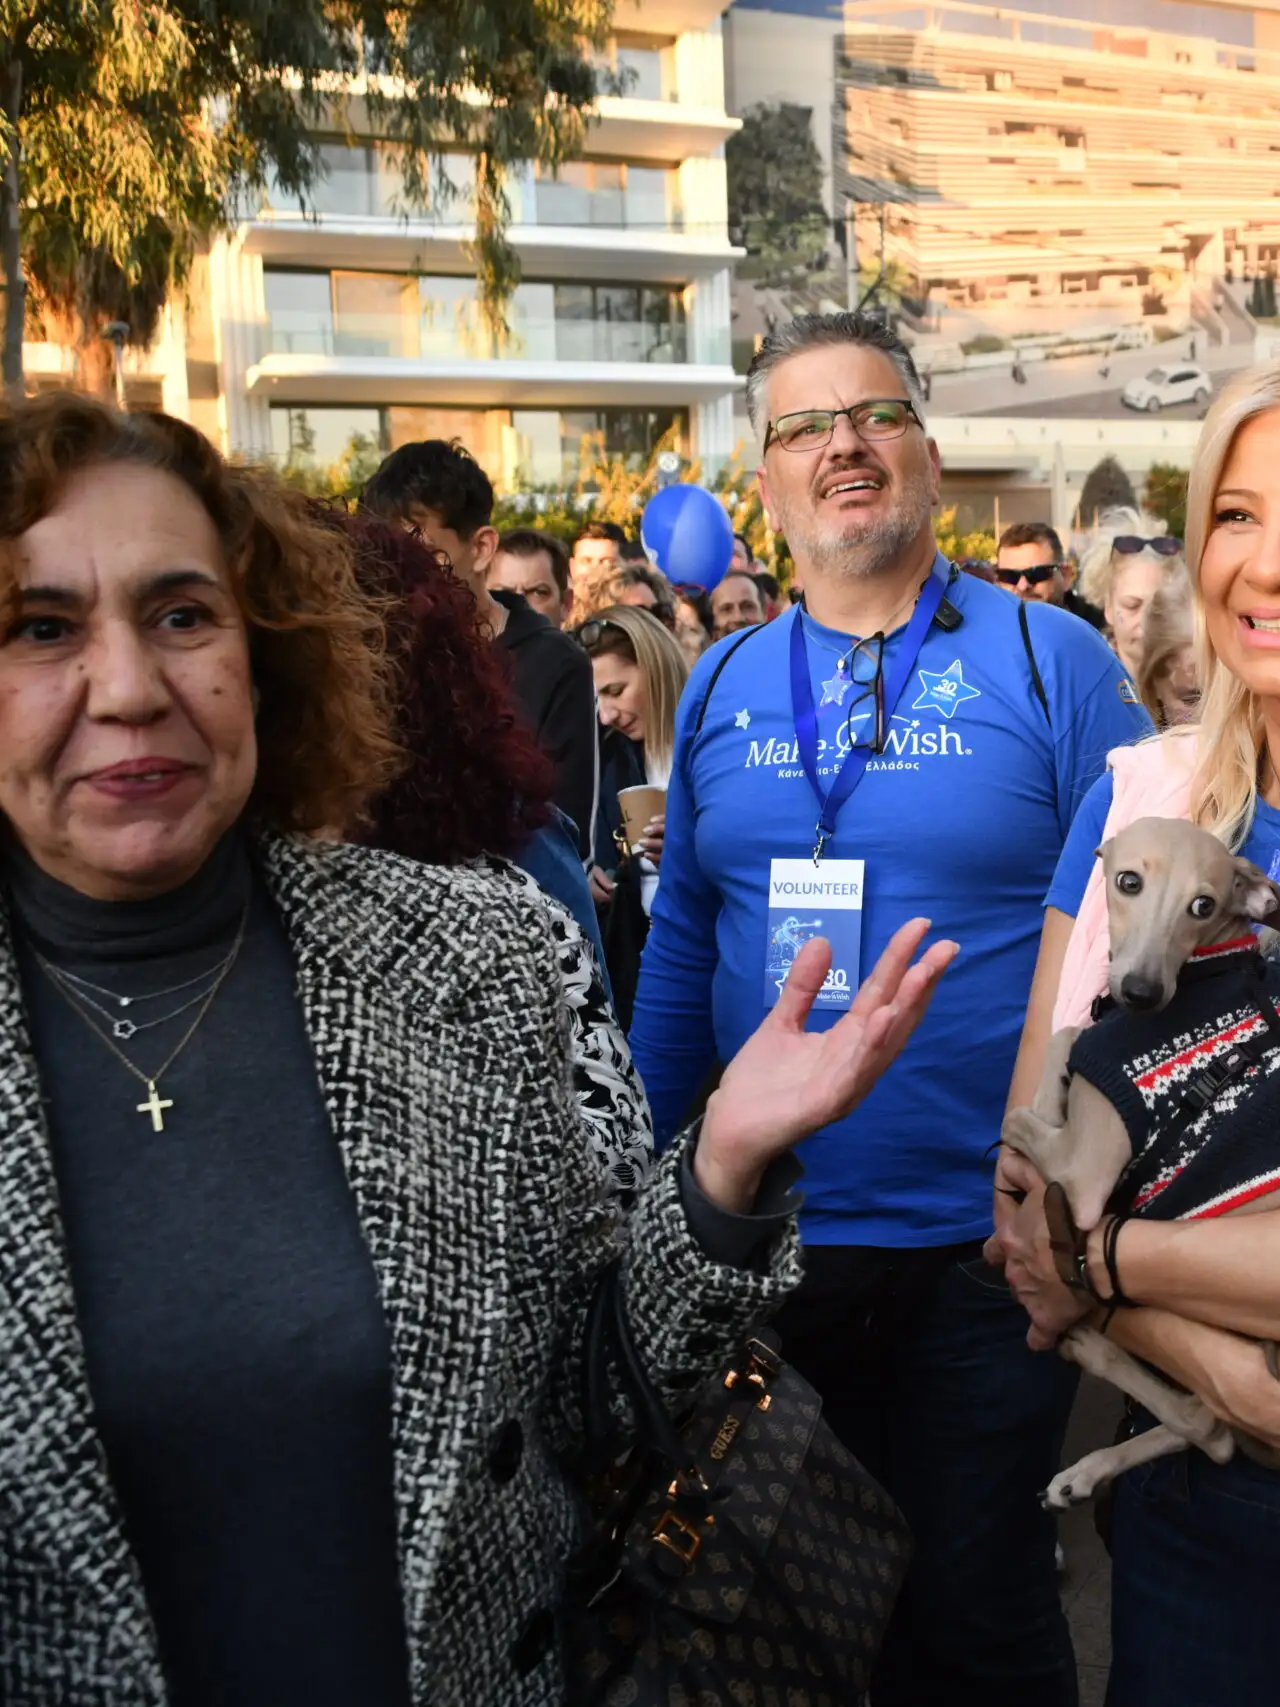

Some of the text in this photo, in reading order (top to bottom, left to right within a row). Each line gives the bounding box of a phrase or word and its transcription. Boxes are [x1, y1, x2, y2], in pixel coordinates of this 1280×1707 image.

[773, 881, 858, 895] VOLUNTEER
[824, 968, 847, 987] 30
[711, 1414, 740, 1459] GUESS
